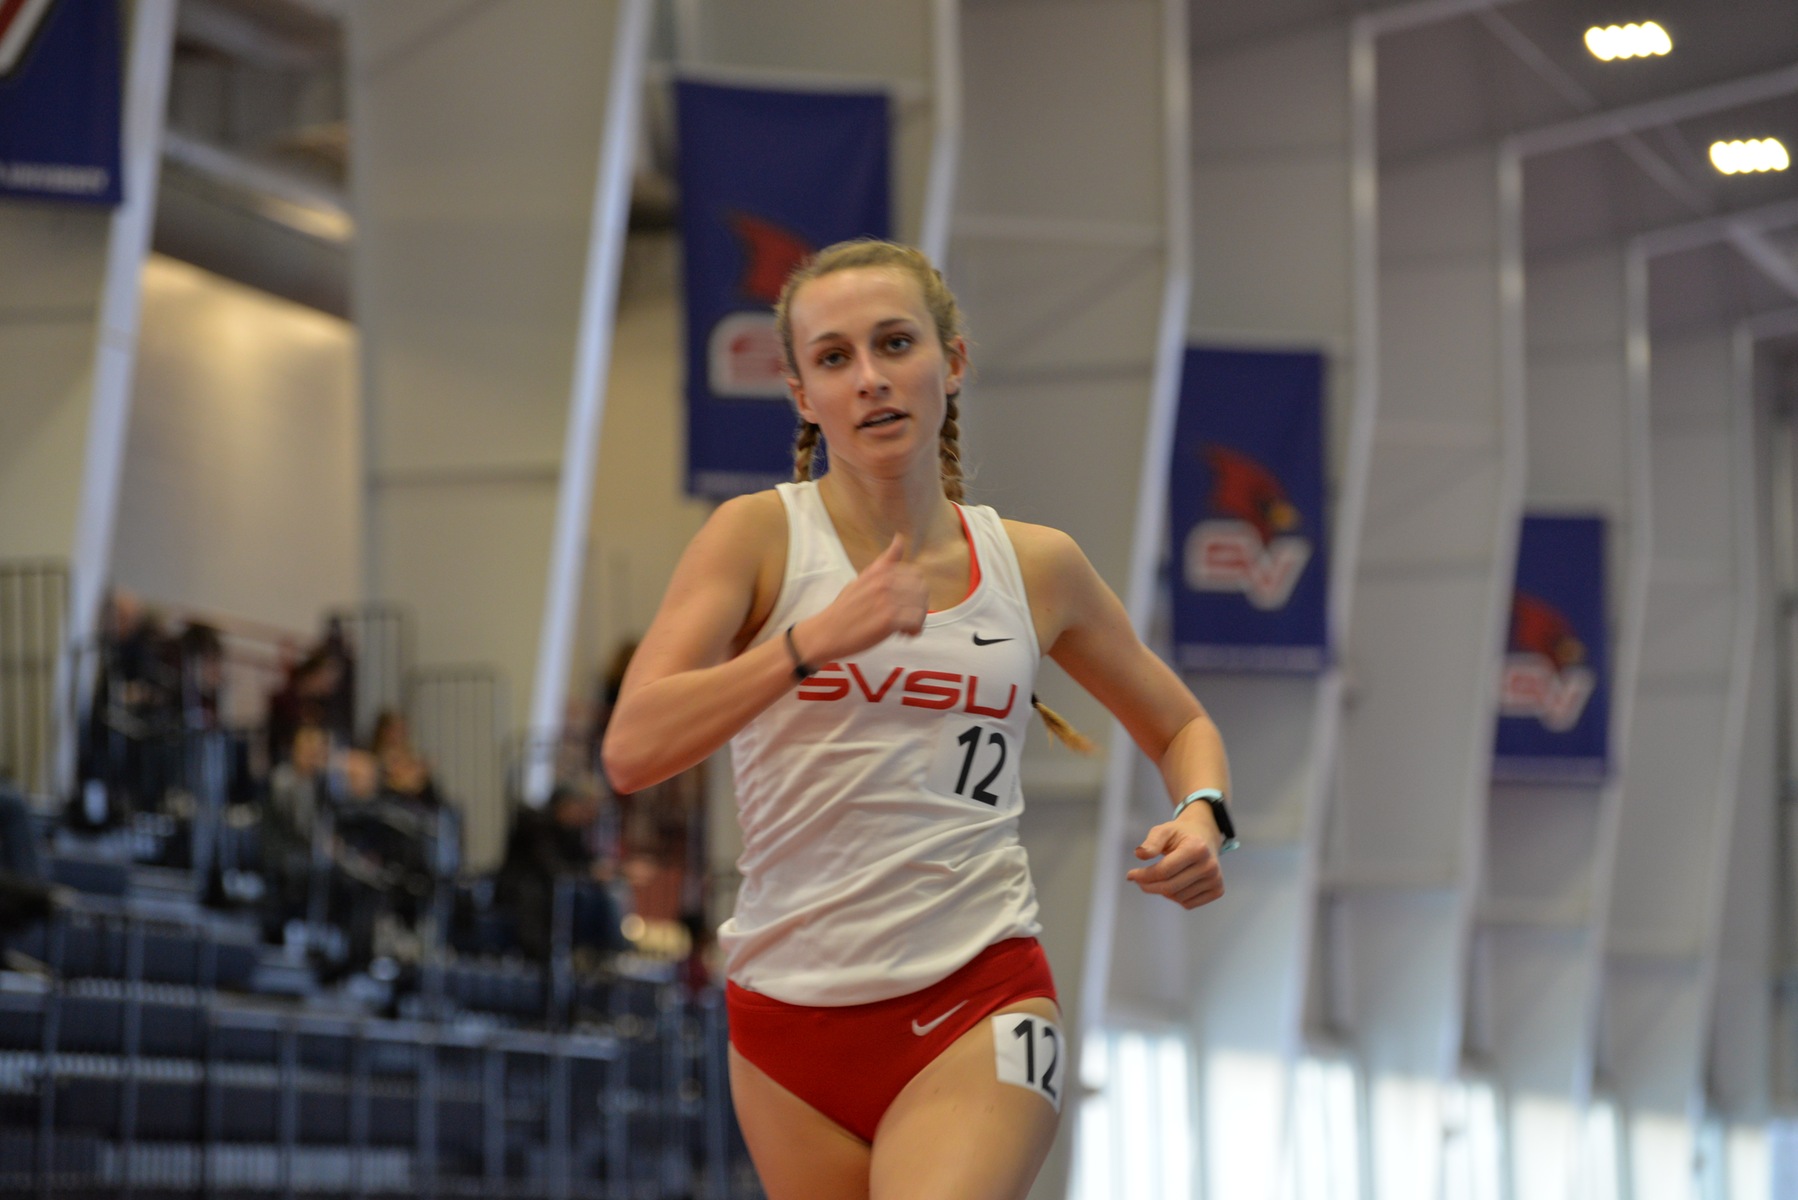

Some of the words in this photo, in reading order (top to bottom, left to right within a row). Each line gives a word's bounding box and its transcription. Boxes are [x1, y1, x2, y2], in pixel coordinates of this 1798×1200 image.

[797, 662, 1018, 720] SVSU
[954, 725, 1008, 807] 12
[1012, 1018, 1058, 1100] 12
